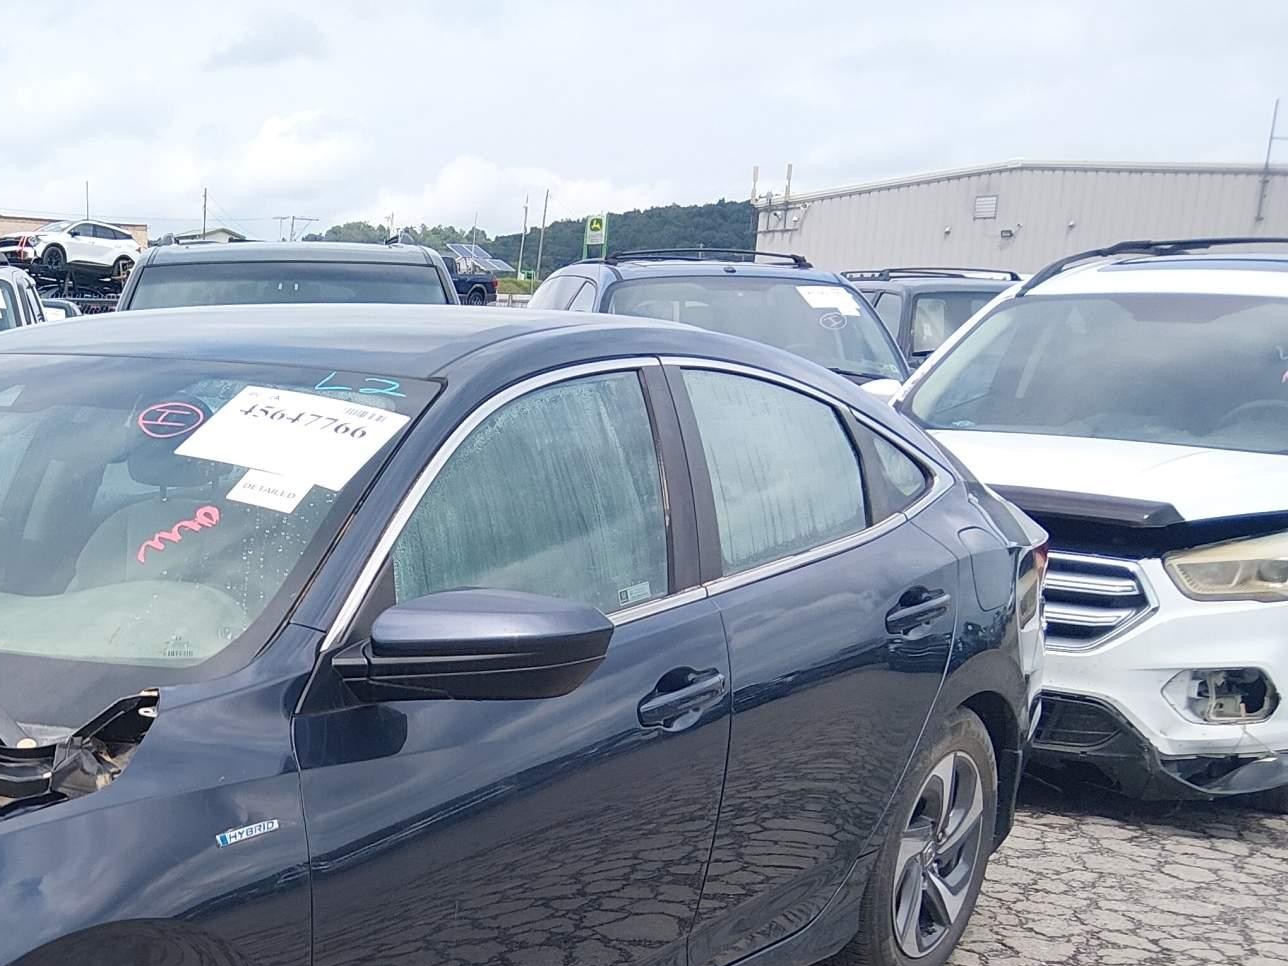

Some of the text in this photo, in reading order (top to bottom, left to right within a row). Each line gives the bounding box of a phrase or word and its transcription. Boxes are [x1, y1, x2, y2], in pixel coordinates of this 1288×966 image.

[239, 403, 368, 440] 45647766
[242, 482, 297, 500] DETAILED
[228, 820, 276, 843] HYBRID
